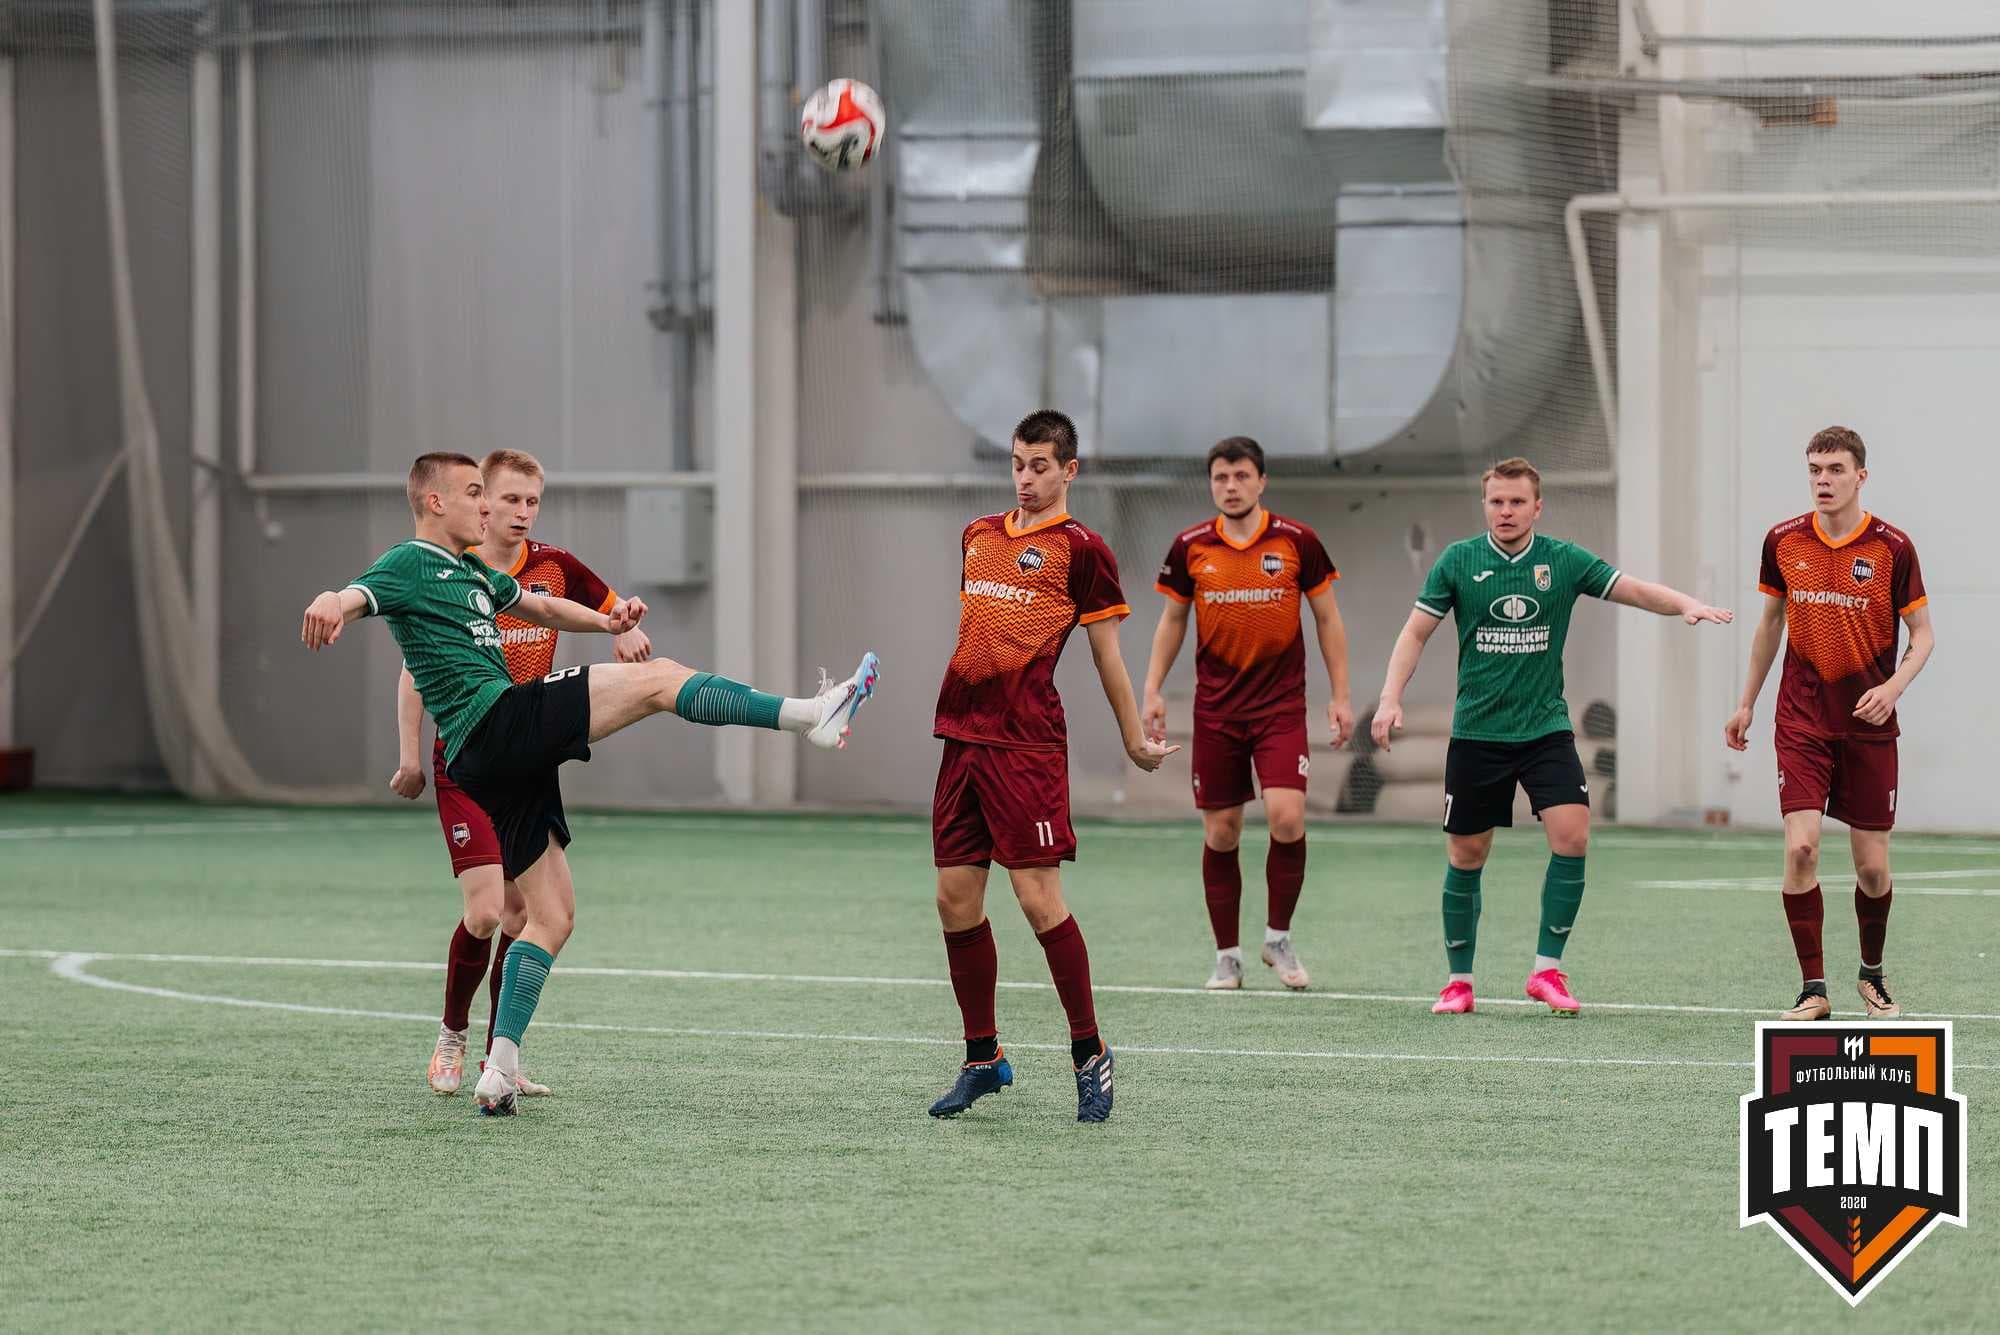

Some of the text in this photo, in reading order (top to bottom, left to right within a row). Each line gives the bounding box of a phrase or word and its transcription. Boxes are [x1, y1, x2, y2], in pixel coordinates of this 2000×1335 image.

[1853, 565, 1873, 579] ТЕМП
[1792, 590, 1869, 610] ПРОДИНВЕСТ
[1476, 642, 1549, 654] ФЕРРОСПЛАВЫ
[1444, 793, 1454, 827] 7
[1035, 821, 1054, 847] 11
